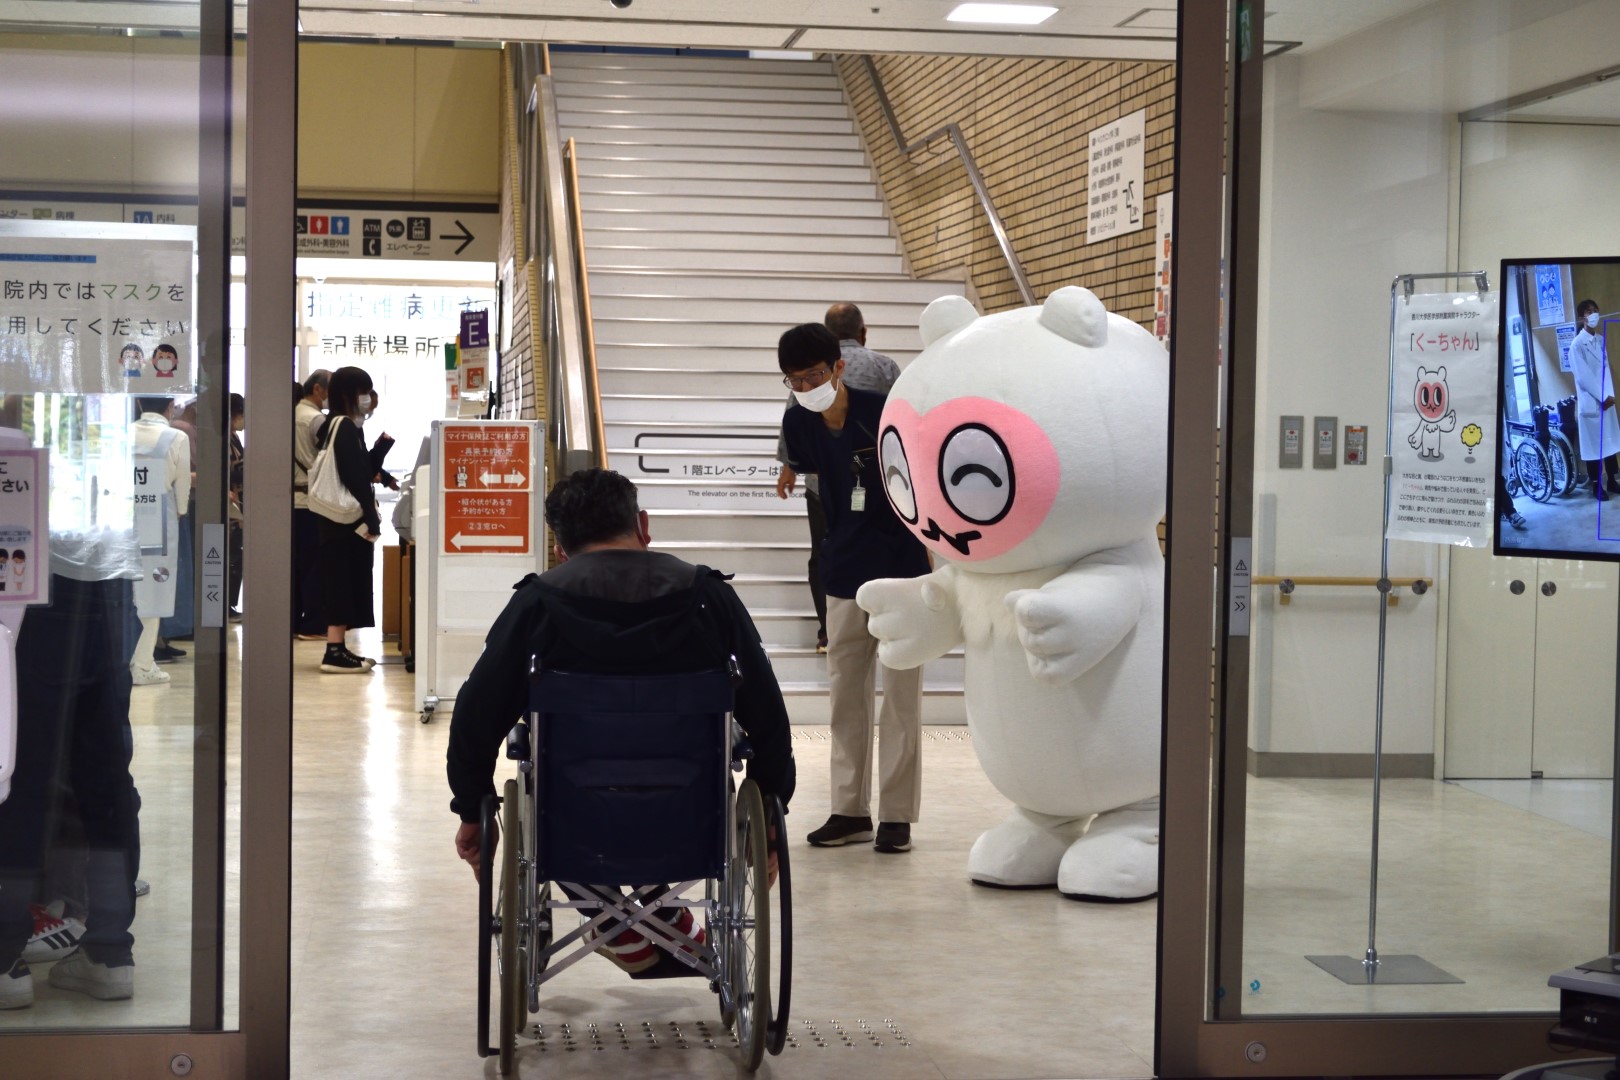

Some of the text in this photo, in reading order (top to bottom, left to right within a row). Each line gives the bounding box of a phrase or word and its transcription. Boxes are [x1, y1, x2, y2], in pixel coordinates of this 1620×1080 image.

[364, 224, 380, 232] ATM
[297, 238, 349, 248] 成外科・美容外科
[387, 243, 430, 251] エレベーター
[4, 280, 184, 302] 院内ではマスクを
[7, 316, 185, 336] 用してください
[469, 322, 479, 346] E
[322, 334, 440, 359] 記載場所
[1410, 331, 1480, 352] 「くーちゃん」
[682, 465, 785, 476] 1階エレベーターは
[0, 479, 29, 493] さい
[751, 490, 764, 498] first
